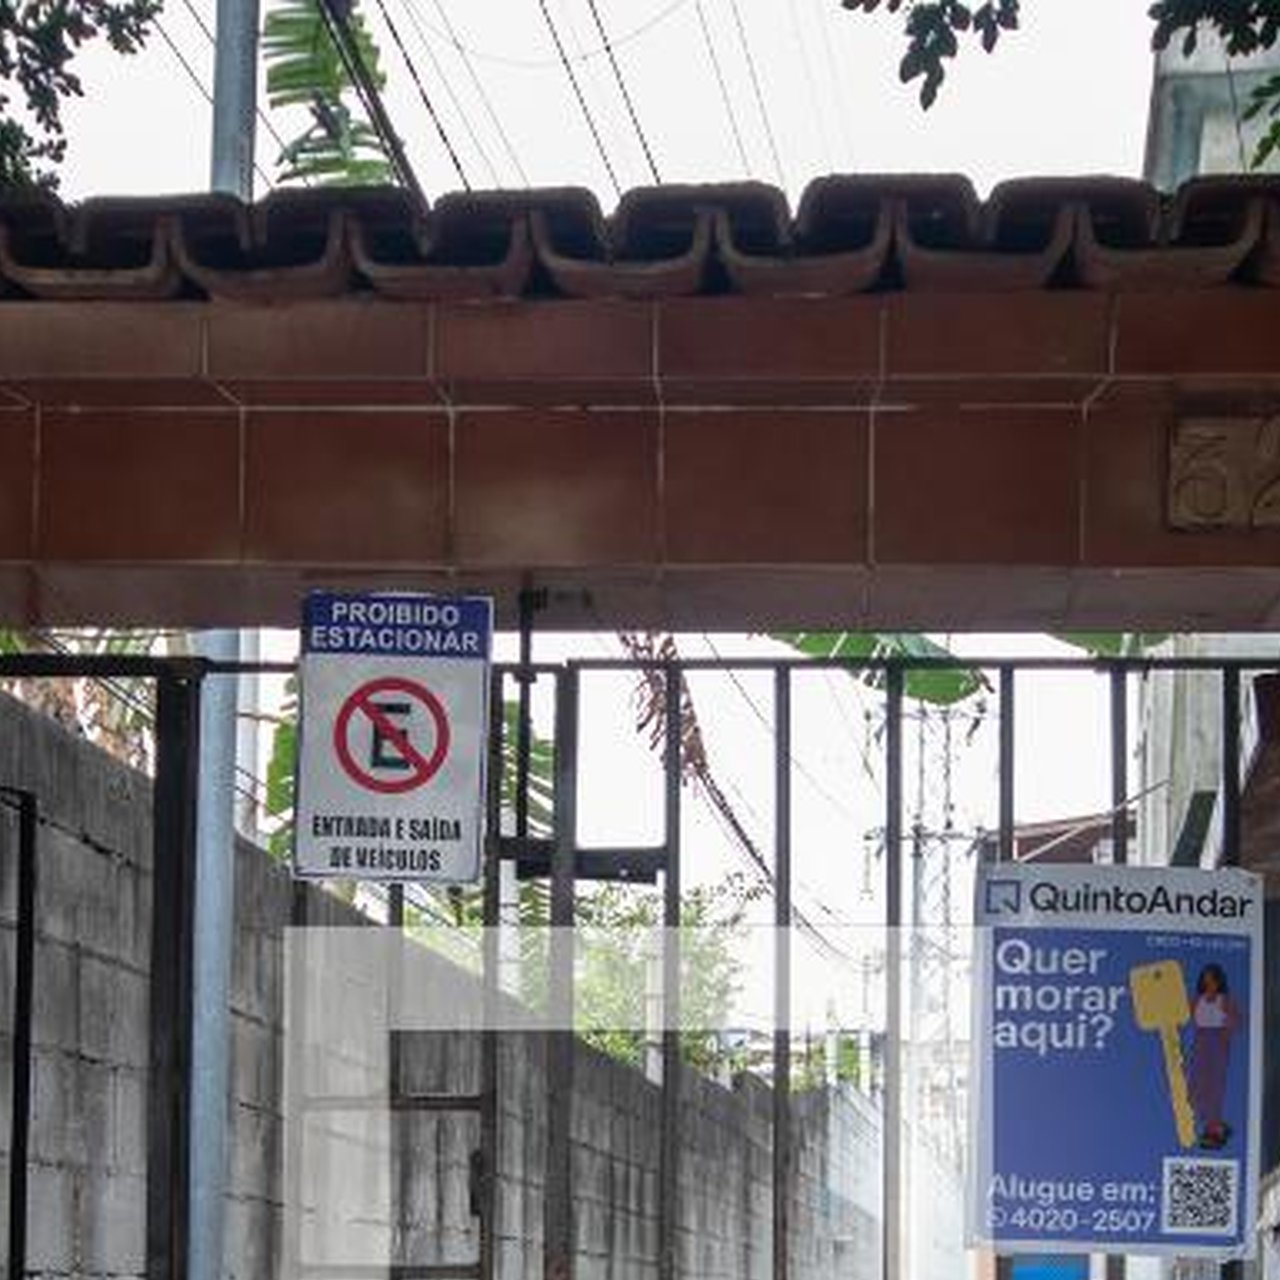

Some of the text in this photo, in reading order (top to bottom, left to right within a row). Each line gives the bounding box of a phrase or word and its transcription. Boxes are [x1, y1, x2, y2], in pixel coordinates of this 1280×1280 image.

[331, 601, 460, 627] PROIBIDO
[311, 625, 478, 651] ESTACIONAR
[312, 814, 462, 842] ENTRADA E SAÍDA
[329, 843, 442, 871] DE VEÍCULOS
[1029, 881, 1253, 918] QuintoAndar
[995, 939, 1107, 975] Quer
[994, 983, 1126, 1012] morar
[994, 1014, 1114, 1054] aqui?
[987, 1173, 1156, 1207] Alugue em:
[1010, 1208, 1156, 1233] 4020-2507
